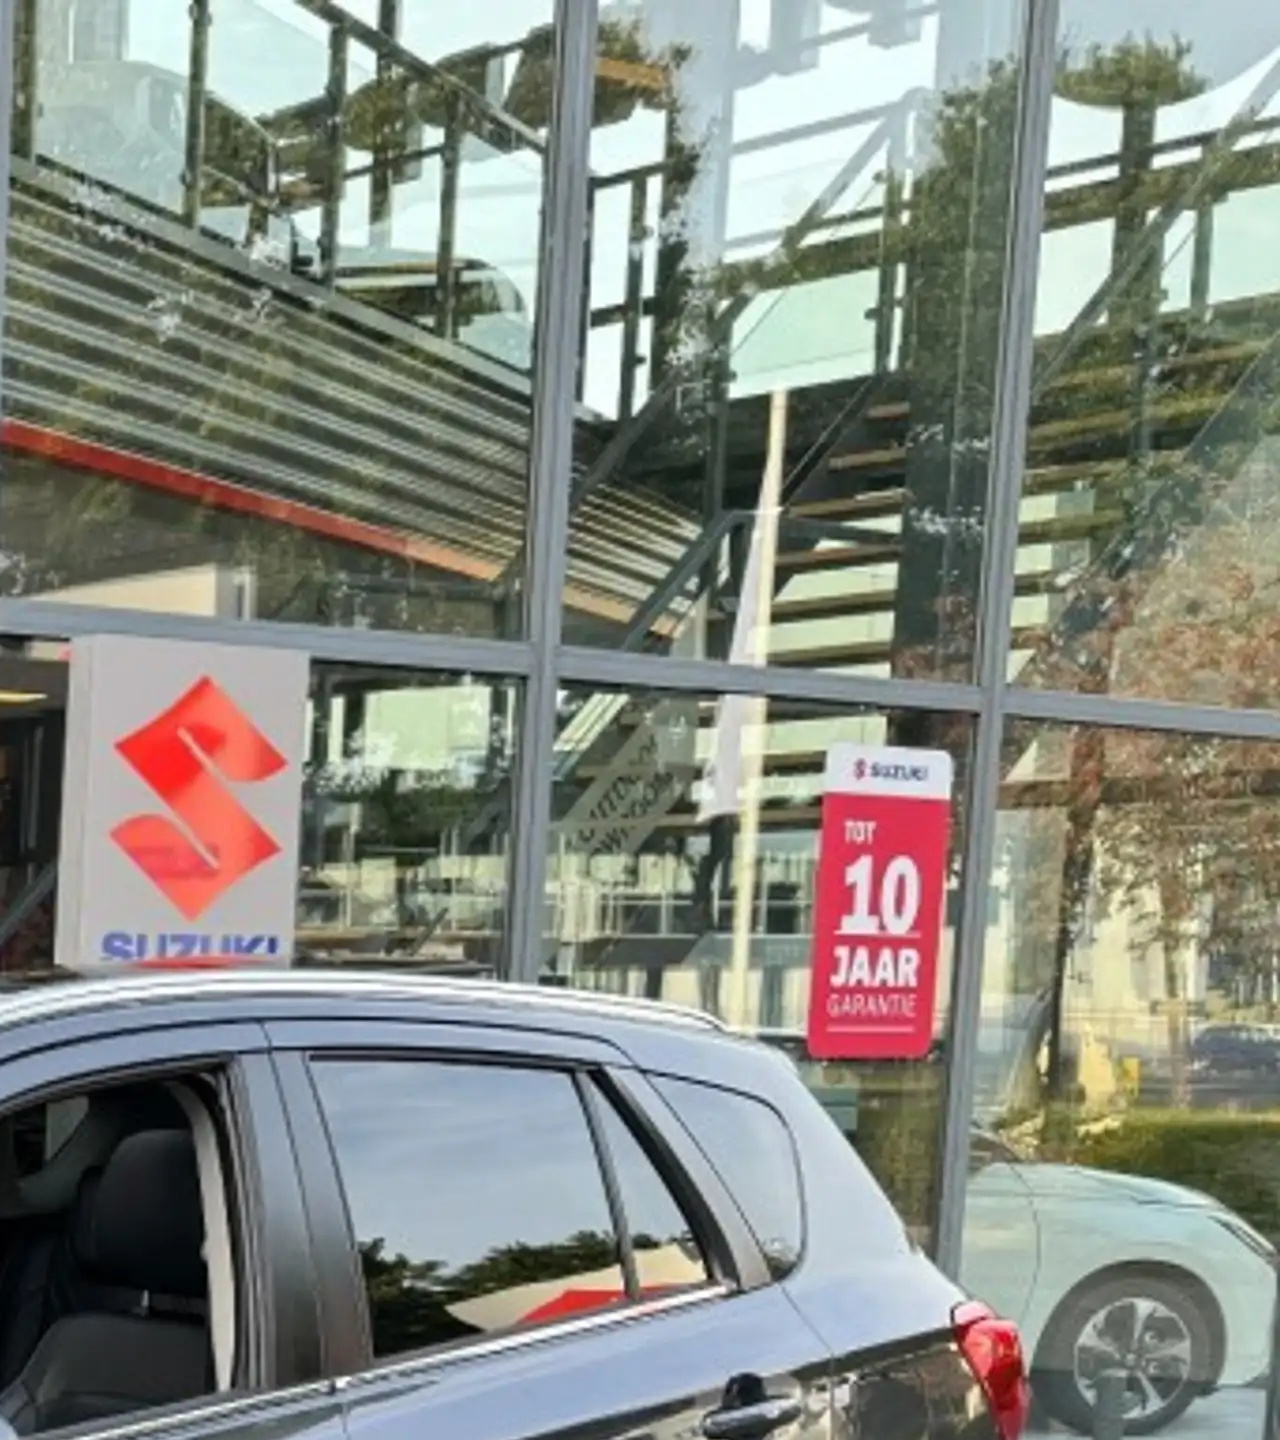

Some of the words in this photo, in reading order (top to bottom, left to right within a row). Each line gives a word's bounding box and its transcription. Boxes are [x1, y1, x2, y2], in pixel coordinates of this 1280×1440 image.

[870, 761, 929, 781] SUZUKI
[844, 820, 876, 844] TOT
[838, 854, 921, 935] 10
[101, 931, 278, 960] SUZUKI
[830, 944, 920, 988] JAAR
[826, 992, 918, 1019] GARANTIE
